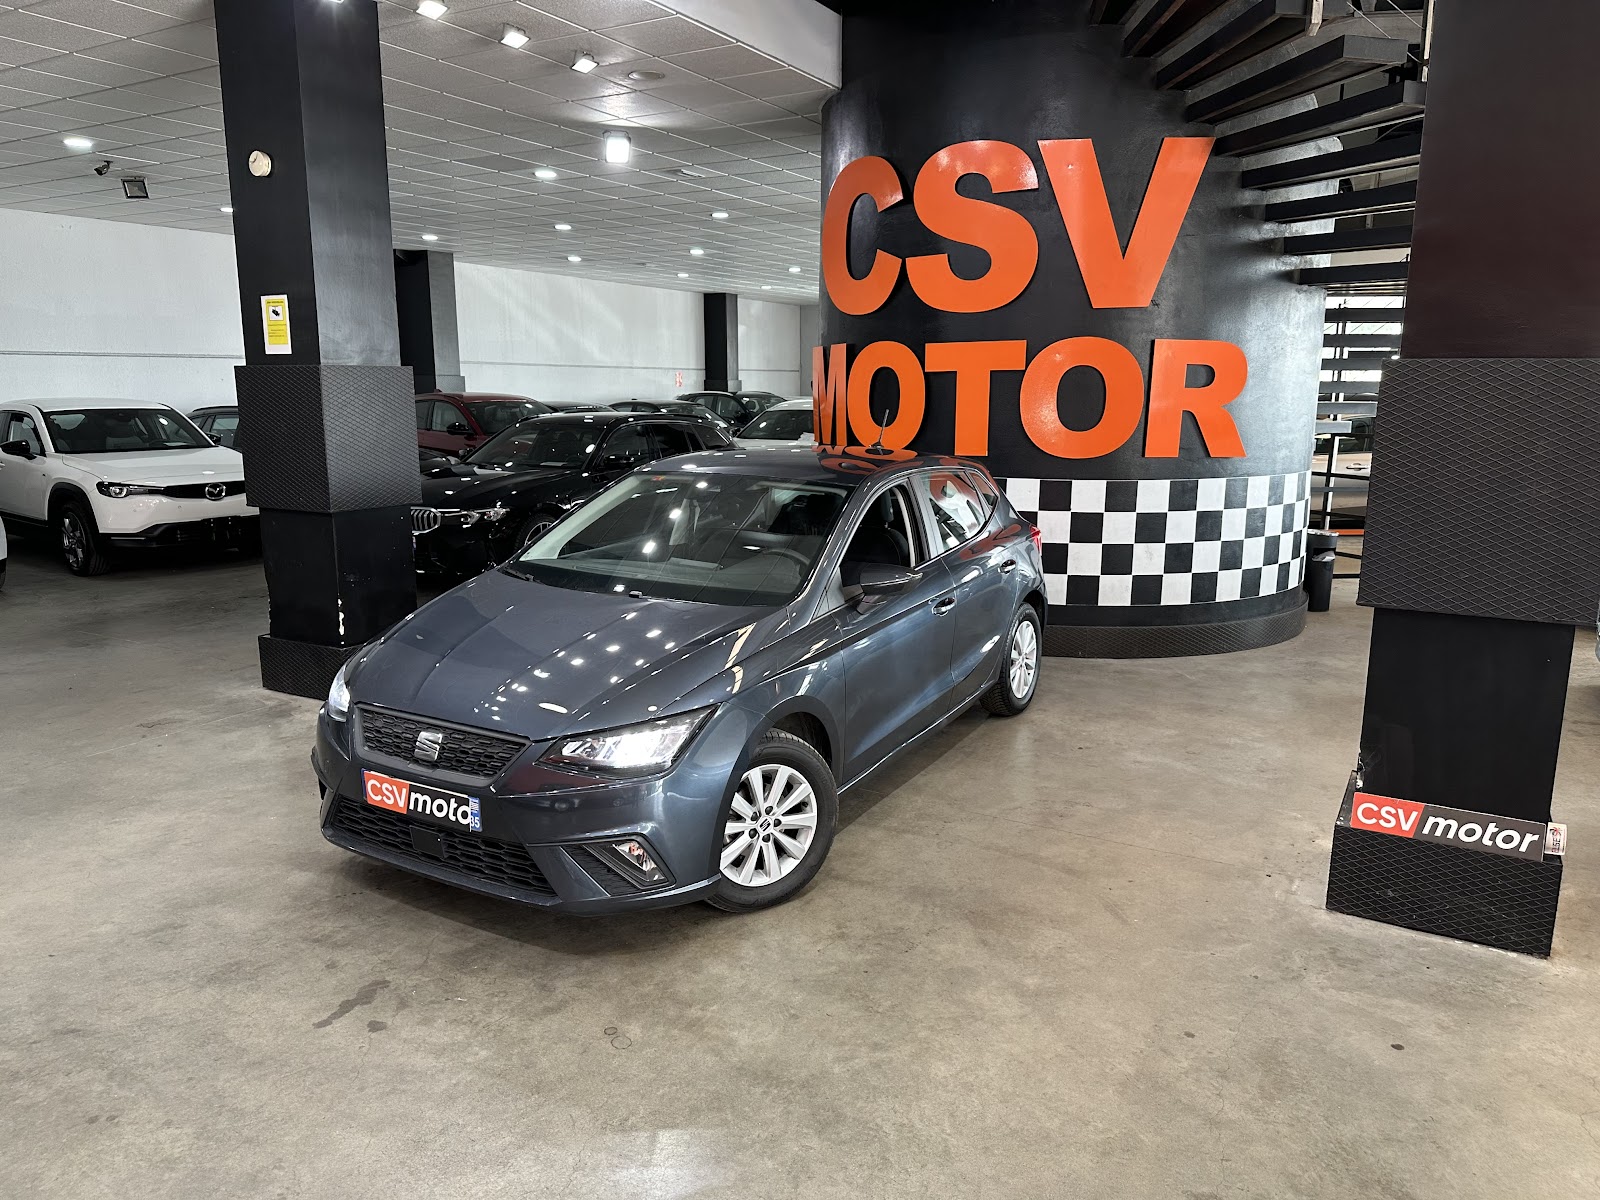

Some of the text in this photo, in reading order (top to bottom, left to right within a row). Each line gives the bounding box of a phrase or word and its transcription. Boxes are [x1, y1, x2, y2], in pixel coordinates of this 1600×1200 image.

[822, 137, 1215, 315] CSV
[812, 336, 1248, 458] MOTOR
[367, 779, 407, 808] CSV
[1356, 802, 1418, 831] CSV
[1422, 815, 1540, 852] motor
